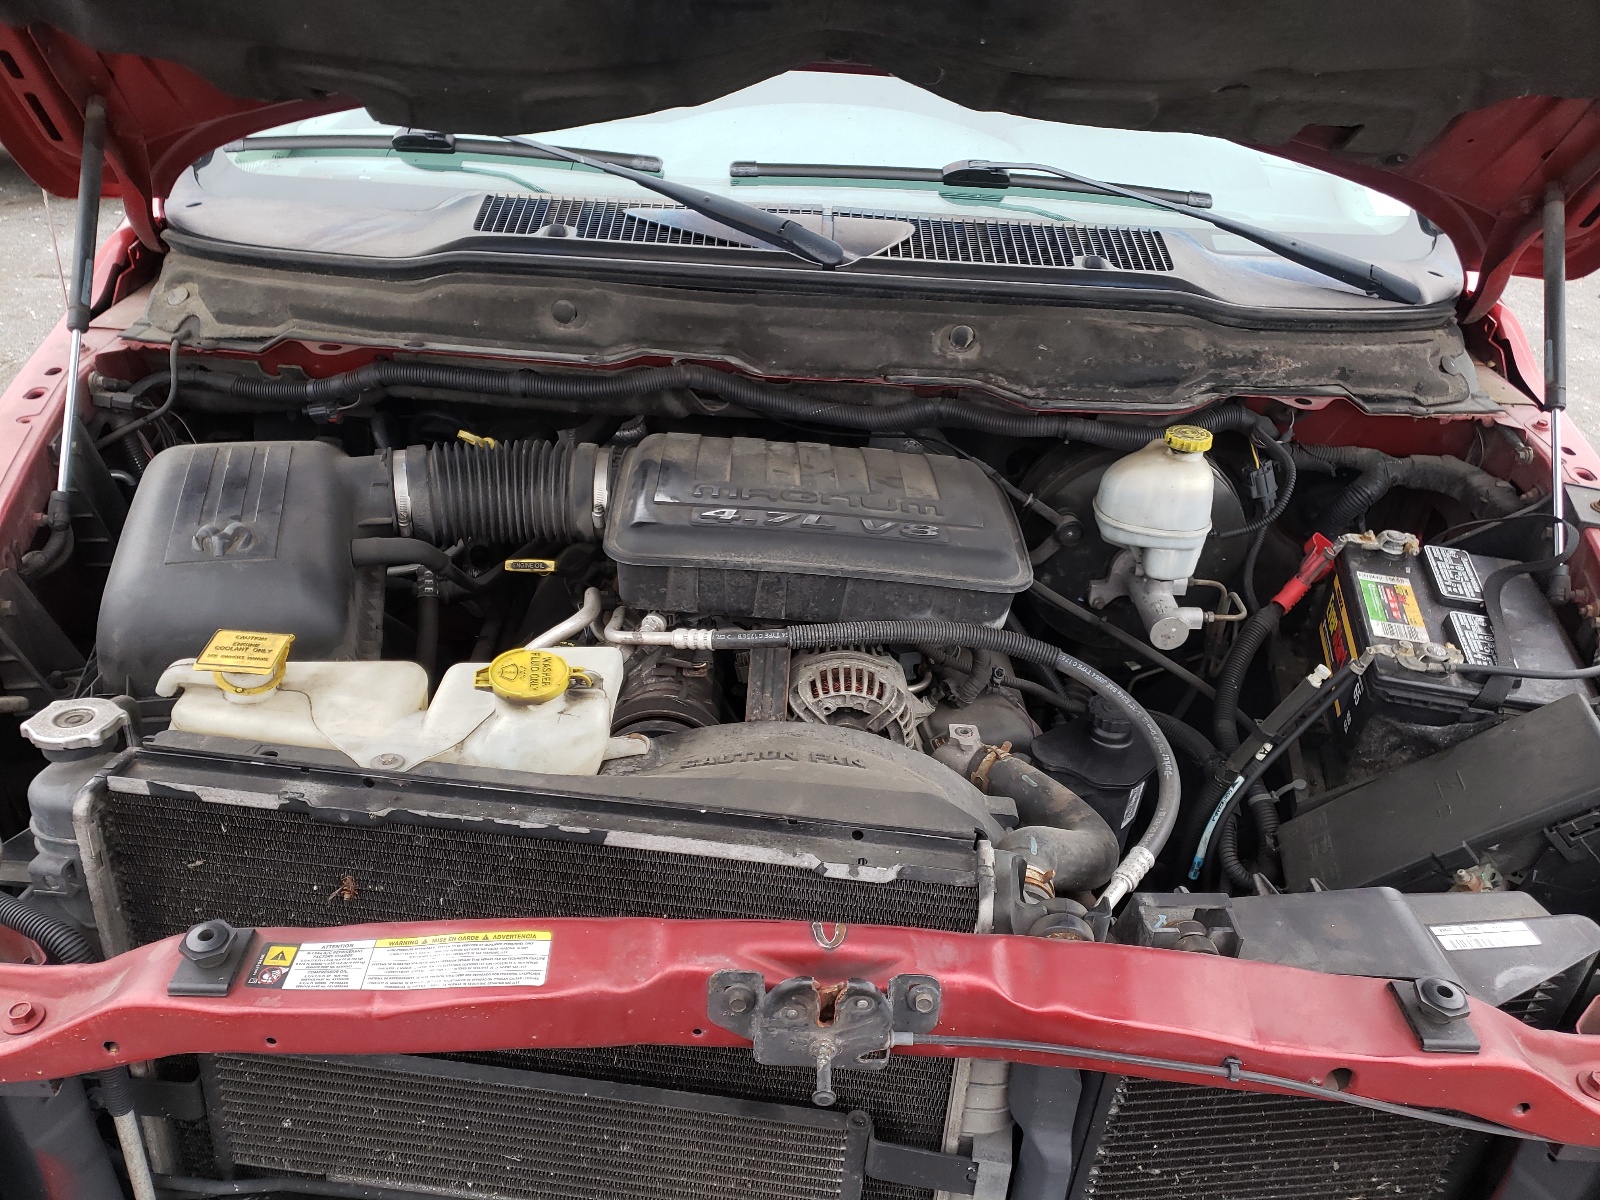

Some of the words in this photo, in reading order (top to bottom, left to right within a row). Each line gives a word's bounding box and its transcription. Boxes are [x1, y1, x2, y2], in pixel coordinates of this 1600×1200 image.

[692, 484, 944, 517] MAGNUM
[700, 508, 836, 530] 4.7L
[860, 518, 940, 540] V8
[530, 652, 540, 671] FLUID
[1077, 664, 1092, 675] TYPE
[542, 656, 552, 687] WASHER
[529, 673, 539, 690] ONLY
[1106, 682, 1117, 693] SAE
[680, 750, 800, 769] CAUTION
[808, 752, 867, 770] FAN
